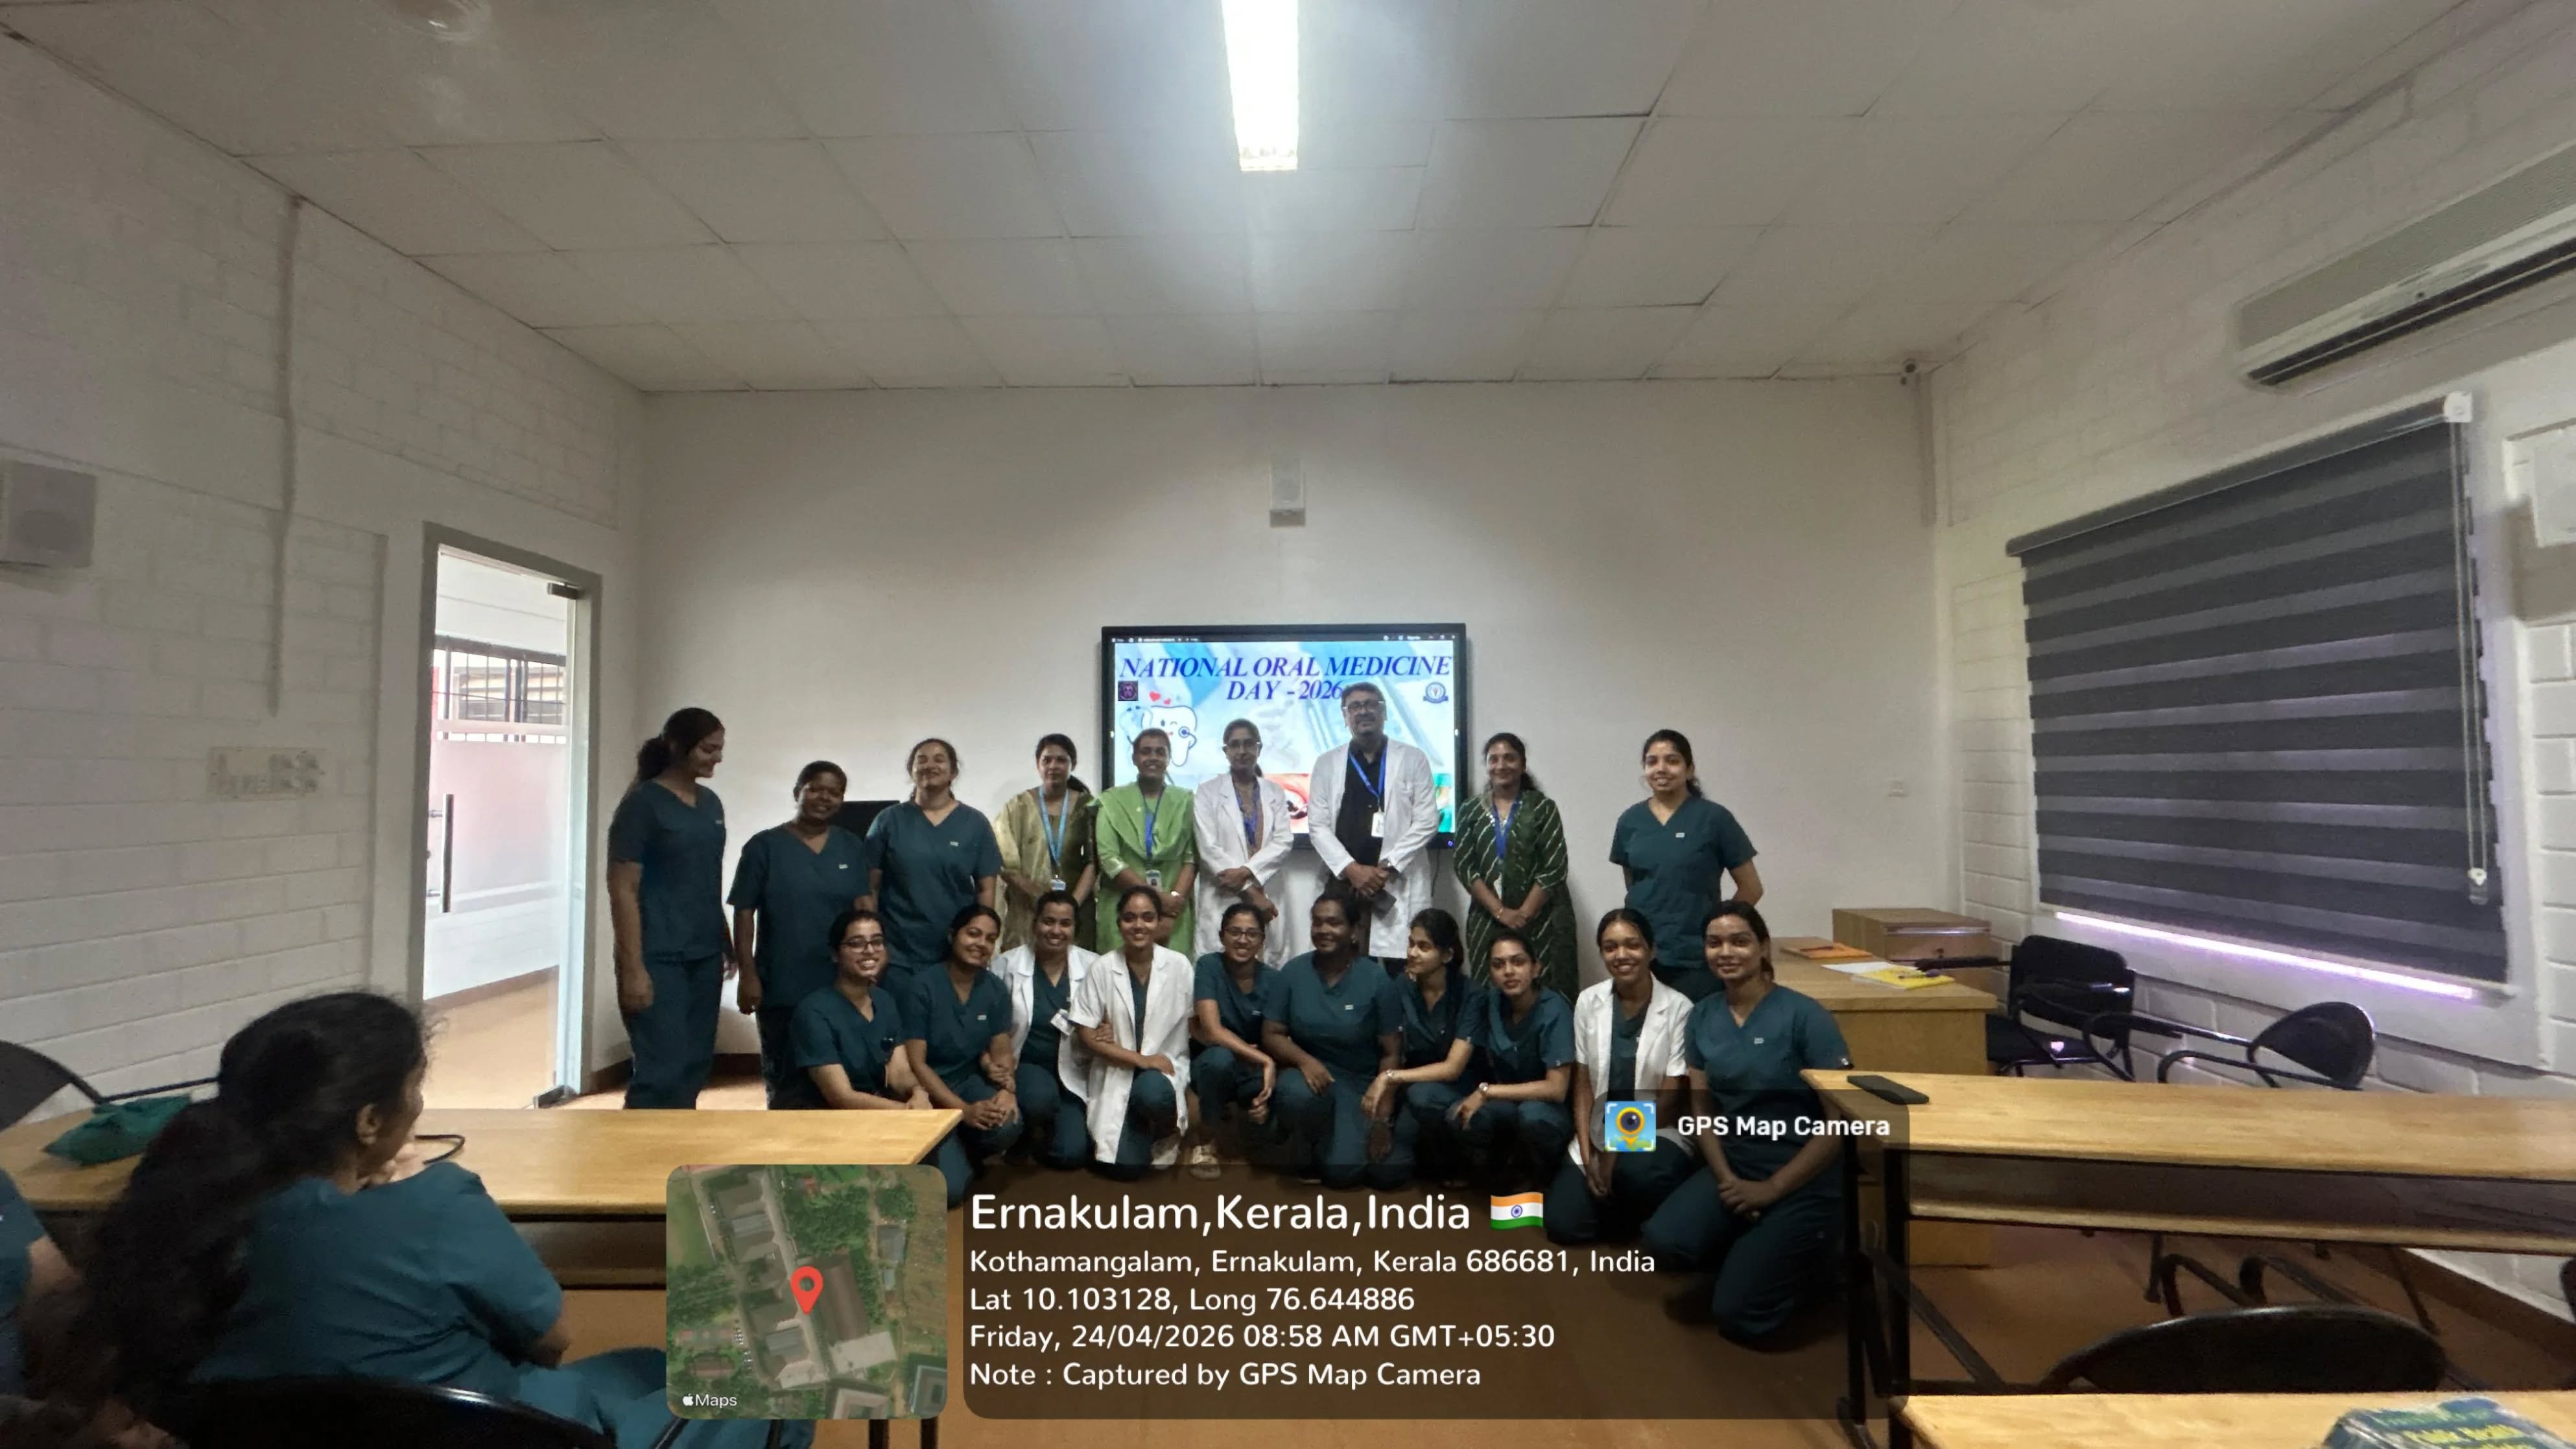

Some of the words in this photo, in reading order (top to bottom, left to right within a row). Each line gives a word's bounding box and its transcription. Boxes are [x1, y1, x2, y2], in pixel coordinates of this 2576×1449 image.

[1120, 657, 1248, 677] NATIONAL
[1253, 657, 1321, 677] ORAL
[1324, 655, 1452, 676] MEDICINE
[1227, 680, 1282, 700] DAY
[1299, 679, 1343, 700] 2026
